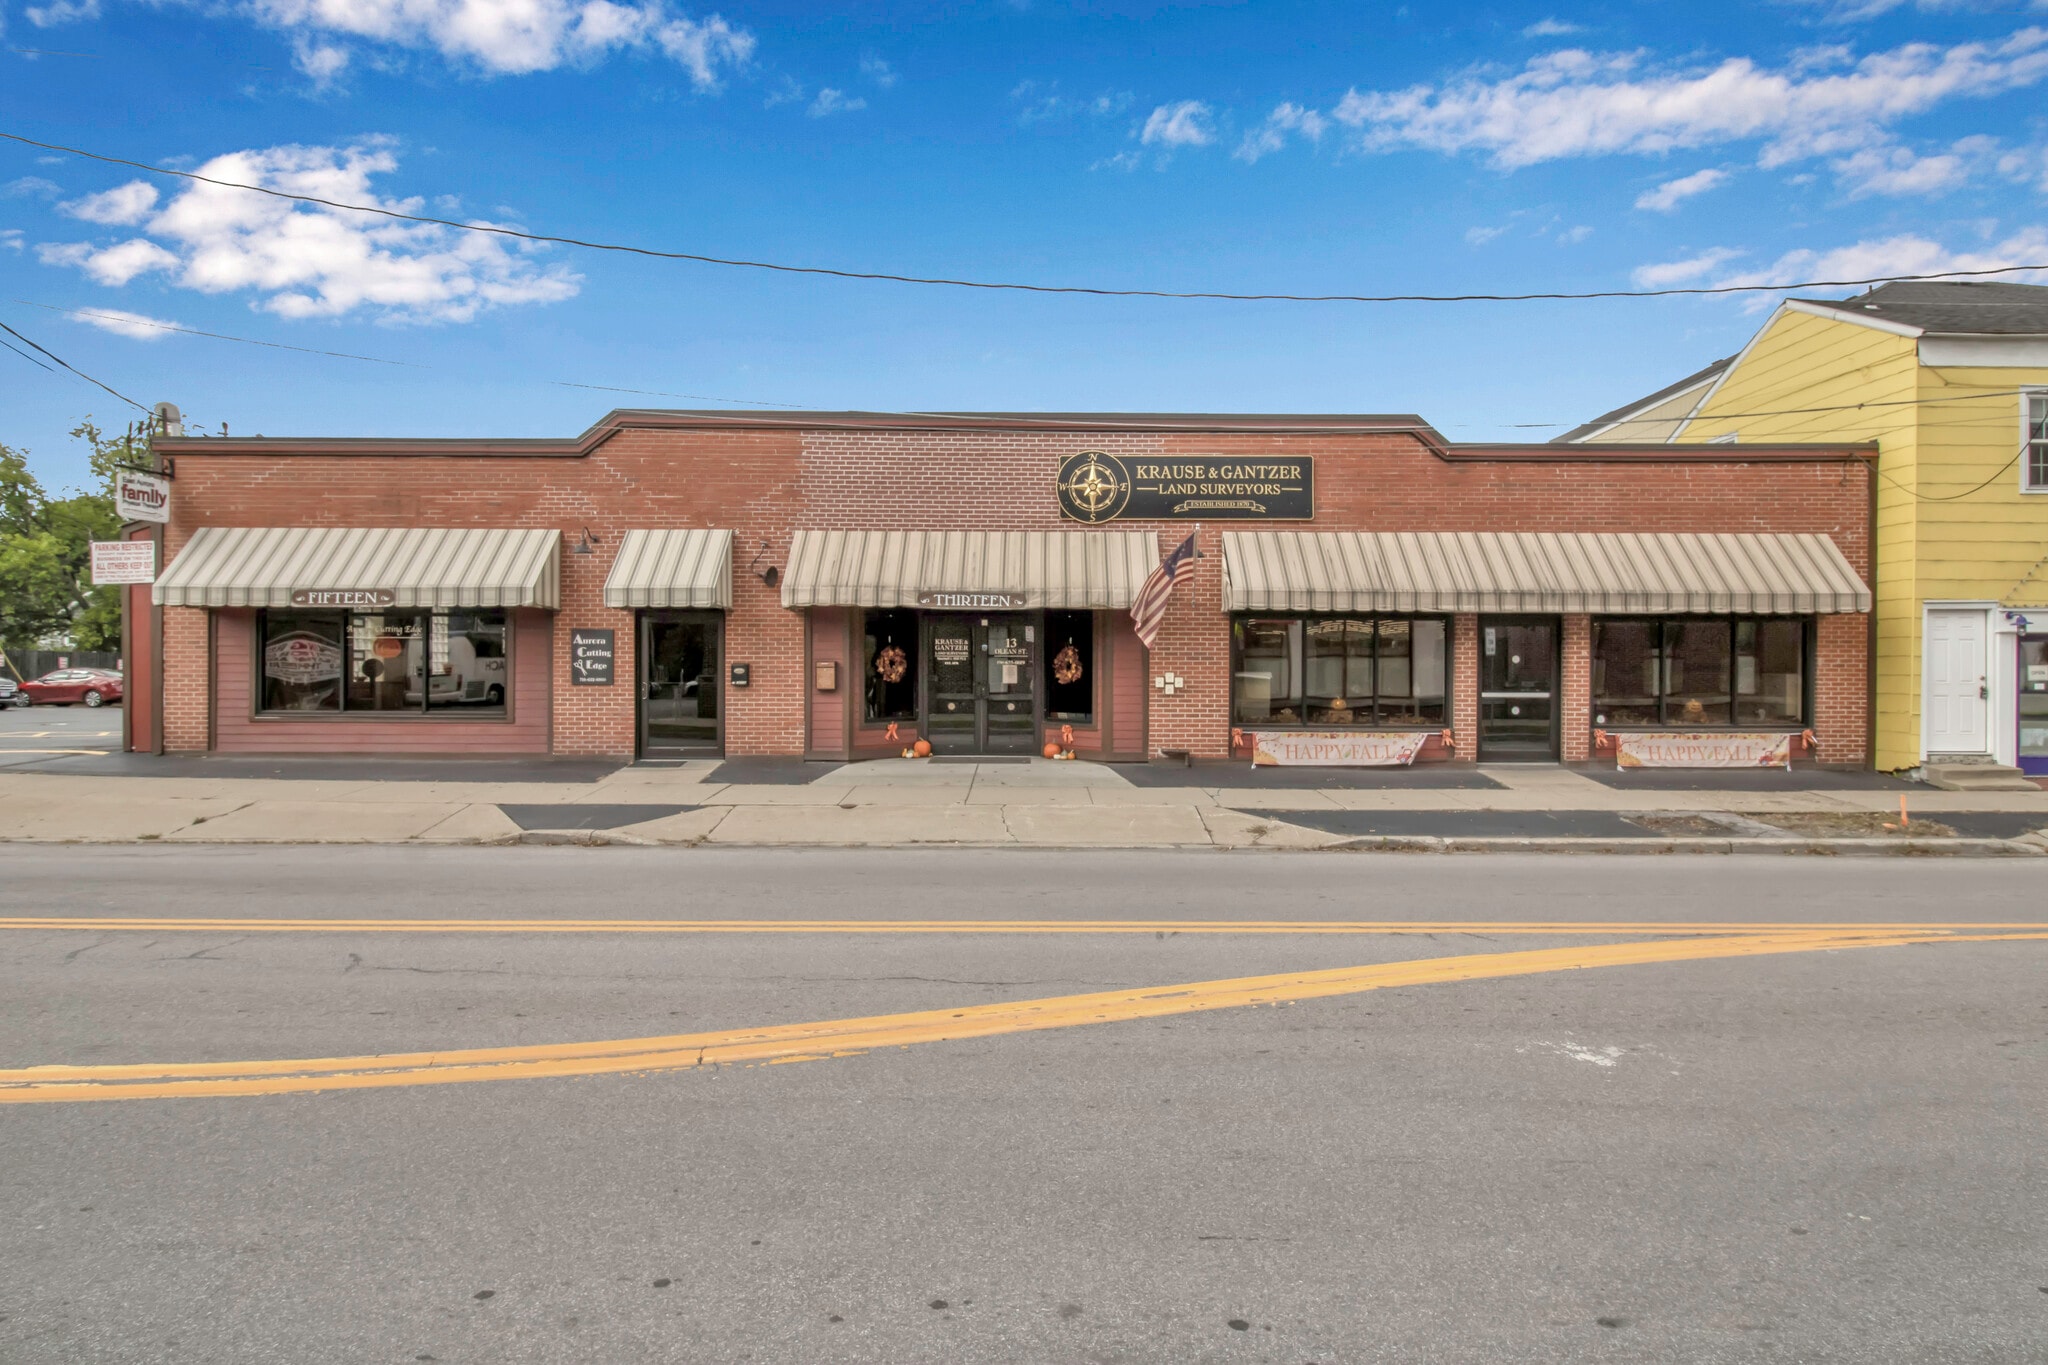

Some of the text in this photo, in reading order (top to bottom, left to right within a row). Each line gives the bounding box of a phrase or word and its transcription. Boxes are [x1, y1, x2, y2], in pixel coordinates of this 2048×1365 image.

[1136, 466, 1302, 479] KRAUSE & GANTZER
[1159, 484, 1281, 495] LAND SURVEYORS
[121, 484, 167, 508] family
[121, 543, 153, 551] RESTRICTED
[107, 562, 129, 570] OTHERS
[130, 562, 142, 570] KEEP
[308, 592, 377, 604] FIFTEEN
[933, 594, 1010, 607] THIRTEEN
[404, 626, 423, 635] Edge
[573, 634, 606, 645] Aurora
[1005, 638, 1017, 648] 13
[577, 646, 612, 658] Cutting
[586, 660, 608, 670] Edge
[1285, 744, 1395, 759] HAPPY FALL
[1648, 745, 1757, 761] HAPPY FALL
